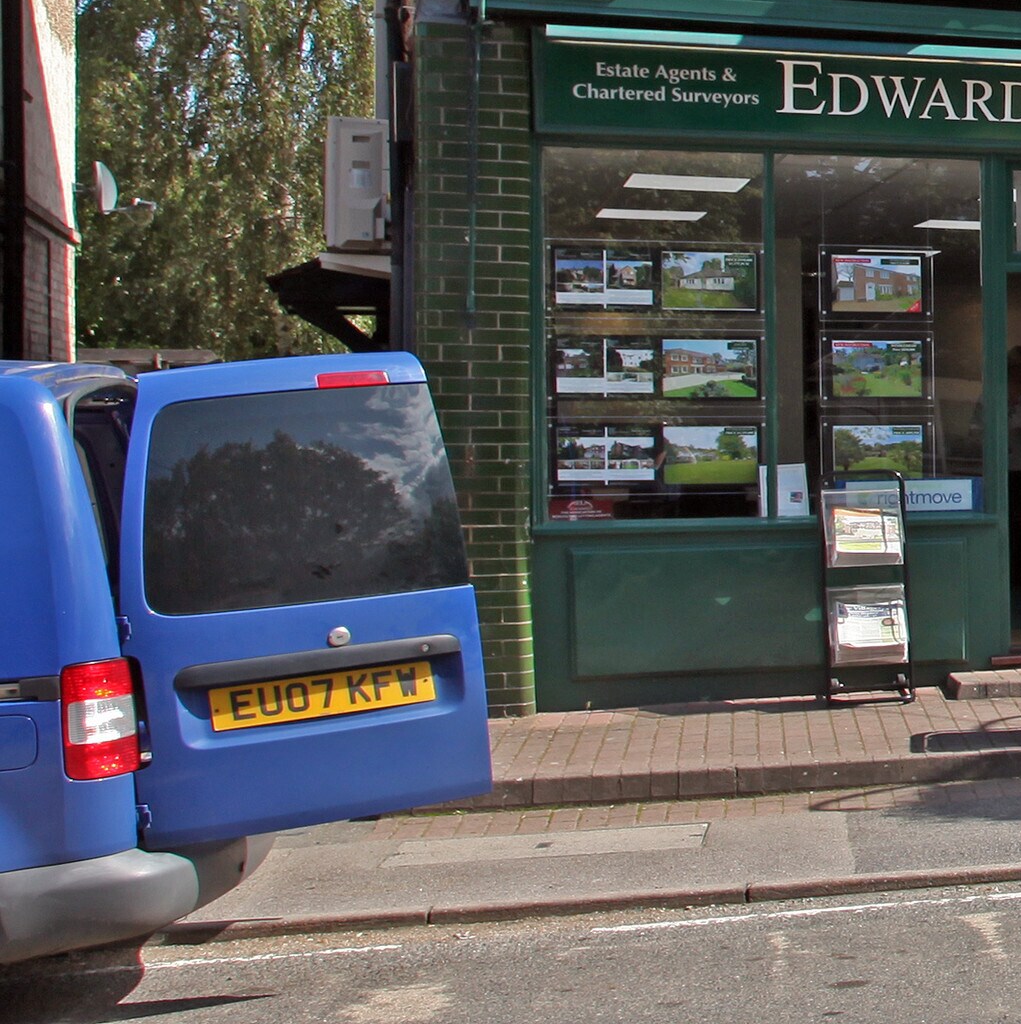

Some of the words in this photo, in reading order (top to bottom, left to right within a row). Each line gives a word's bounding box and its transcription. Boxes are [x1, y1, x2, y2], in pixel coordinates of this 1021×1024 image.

[596, 61, 650, 78] Estate
[655, 64, 717, 84] Agents
[722, 67, 737, 82] &
[572, 83, 666, 102] Chartered
[671, 87, 760, 108] Surveyors
[877, 490, 962, 507] rigtmove
[228, 677, 335, 722] EU07
[347, 666, 418, 705] KFW
